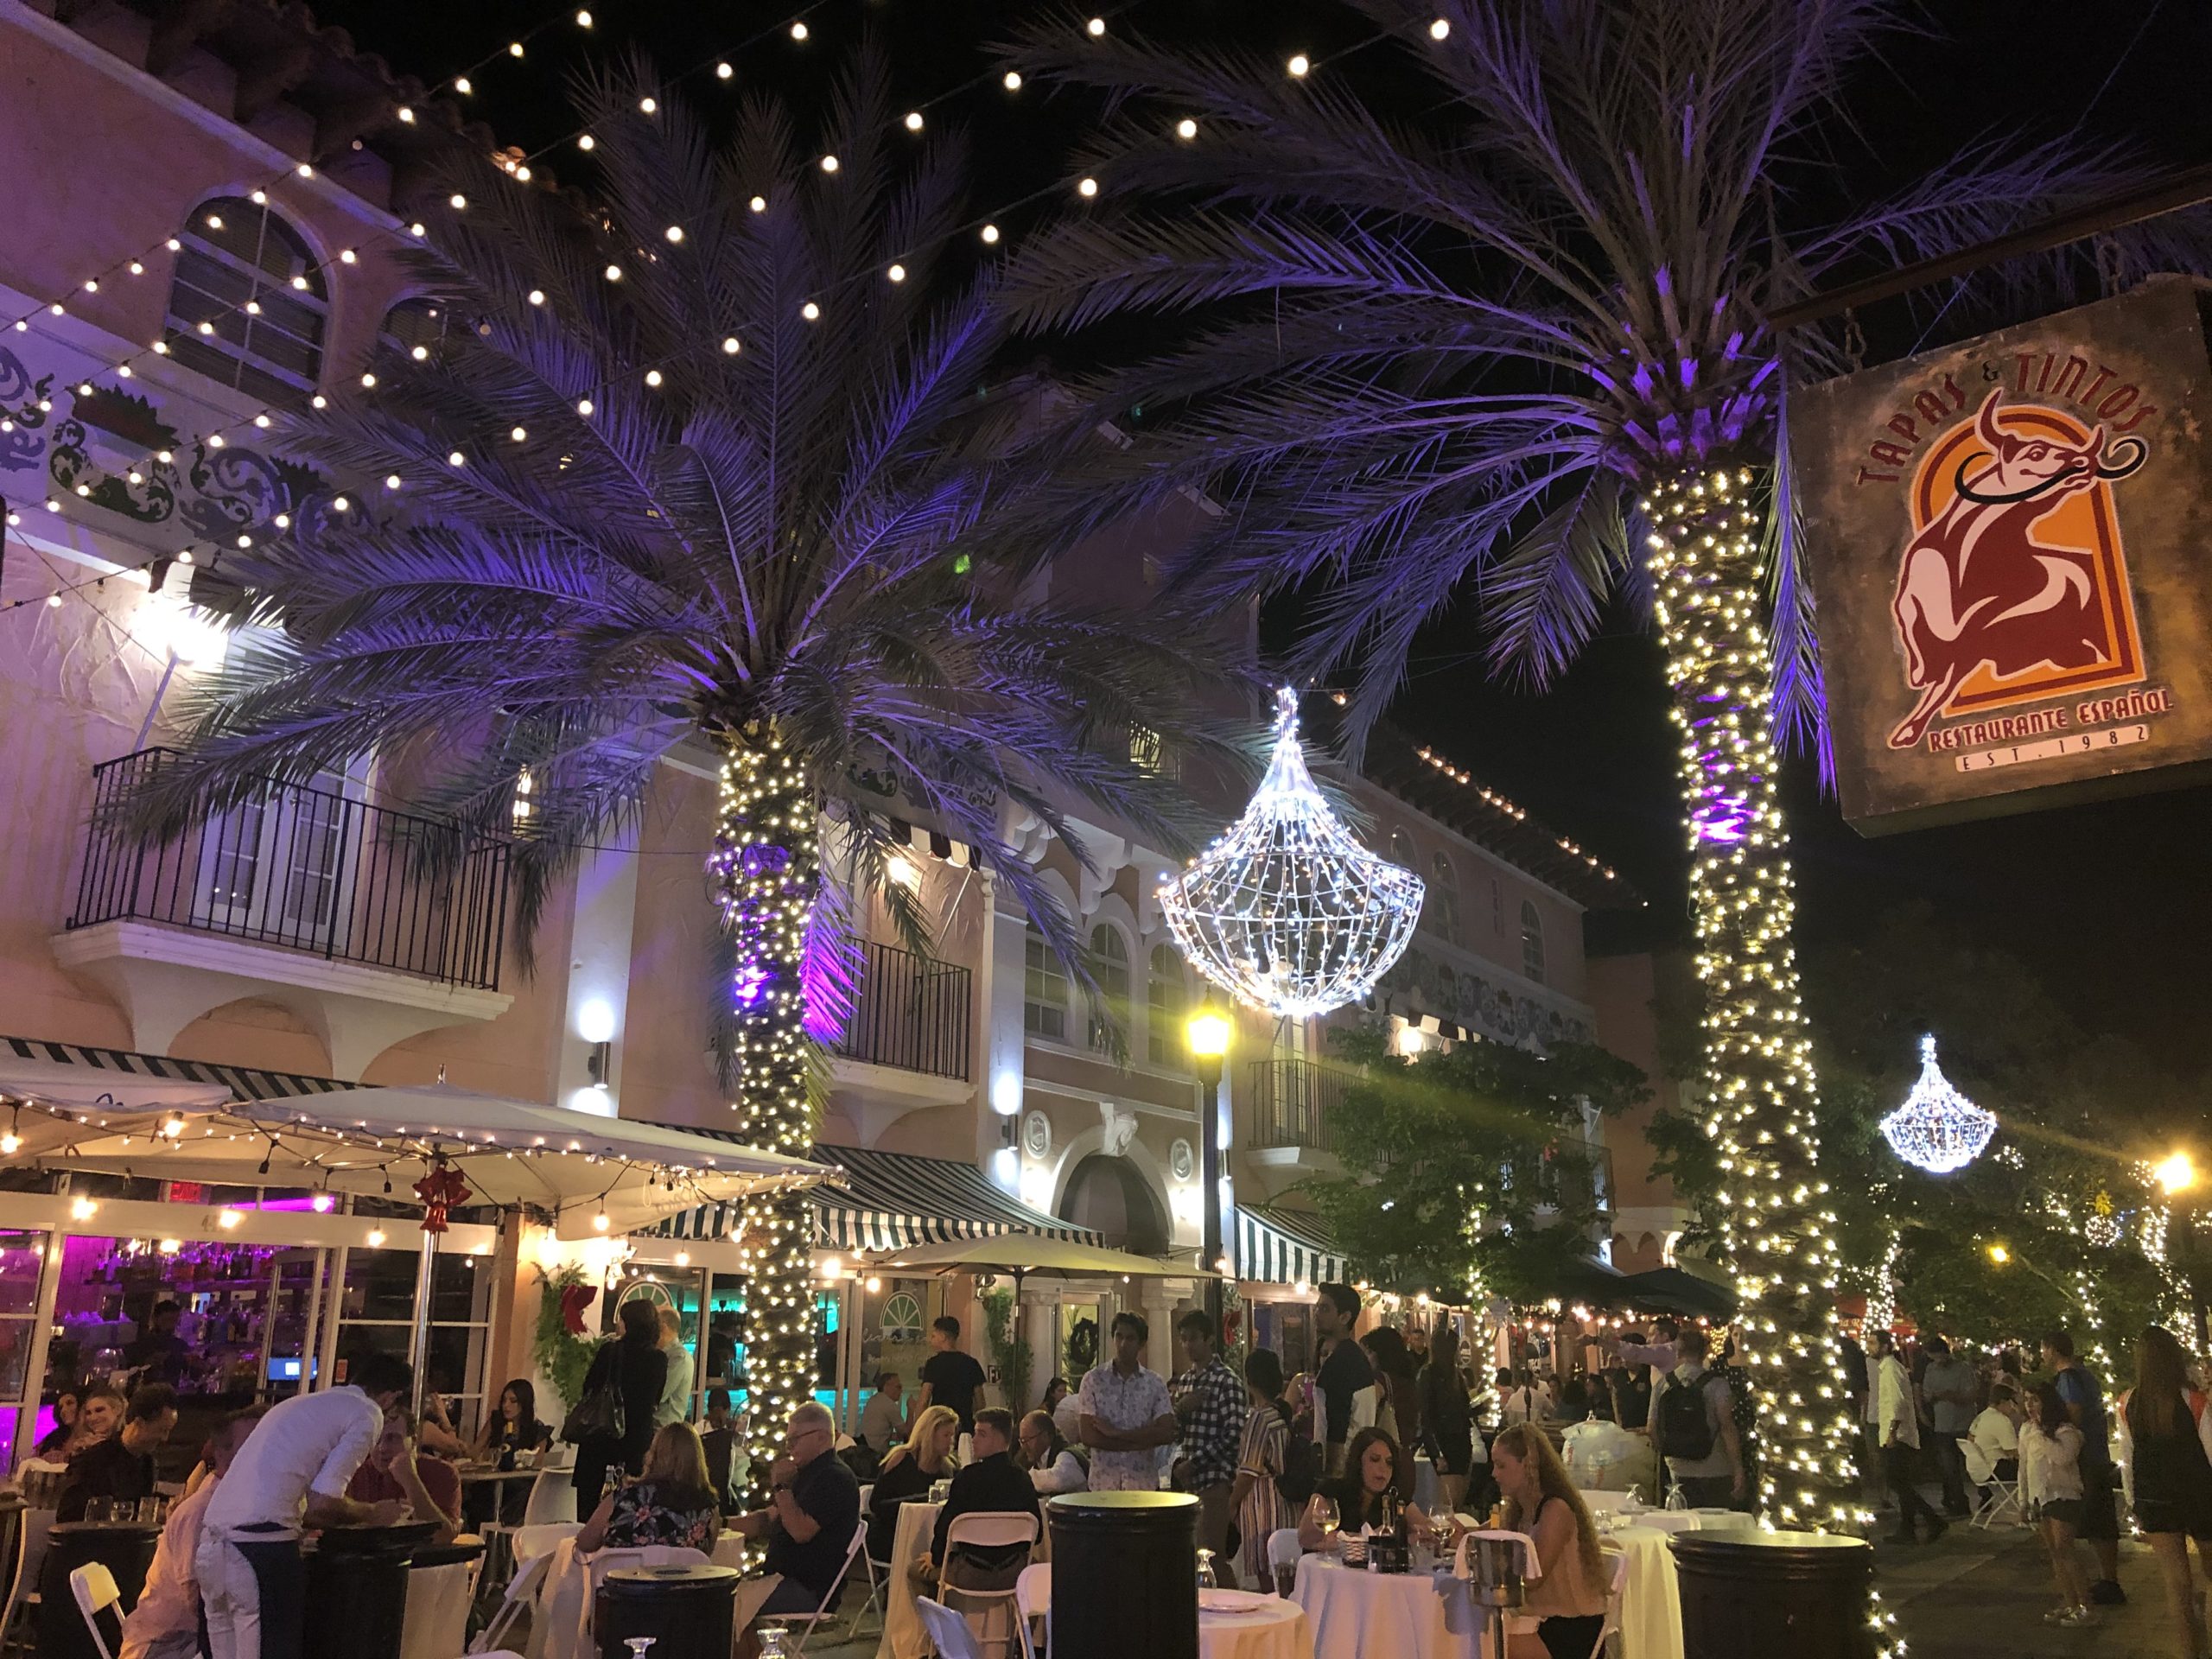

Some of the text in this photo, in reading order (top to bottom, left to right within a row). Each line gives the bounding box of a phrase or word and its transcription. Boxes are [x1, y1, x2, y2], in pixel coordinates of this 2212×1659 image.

[1858, 352, 2158, 485] TAPAS & TINTOS
[1929, 689, 2175, 752] RESTAURANTE ESPAÑOL
